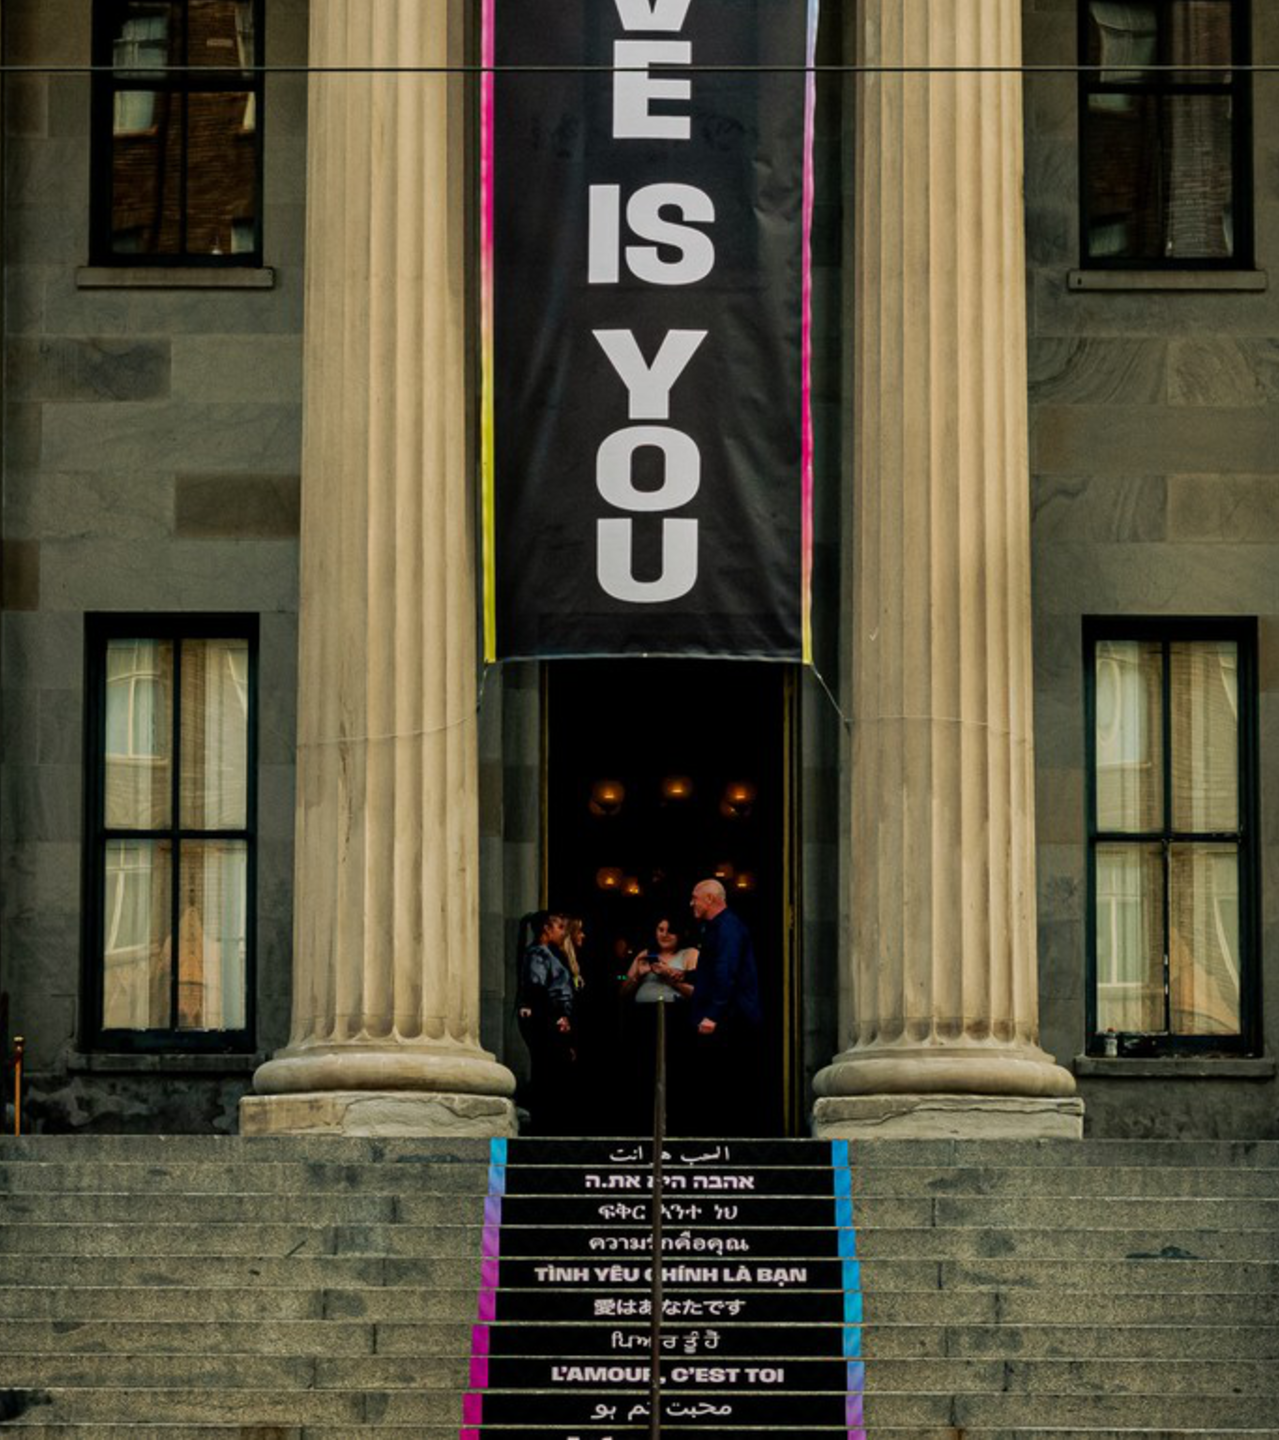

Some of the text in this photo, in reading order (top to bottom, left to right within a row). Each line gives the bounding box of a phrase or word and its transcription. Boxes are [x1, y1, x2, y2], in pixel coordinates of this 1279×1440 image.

[588, 183, 715, 285] IS
[592, 329, 708, 603] YOU
[692, 1175, 755, 1189] אהבה
[534, 1264, 589, 1282] TÌNH
[593, 1264, 640, 1282] YÊU
[722, 1265, 753, 1282] LÀ
[756, 1267, 807, 1287] BẠN
[744, 1368, 785, 1383] TOI
